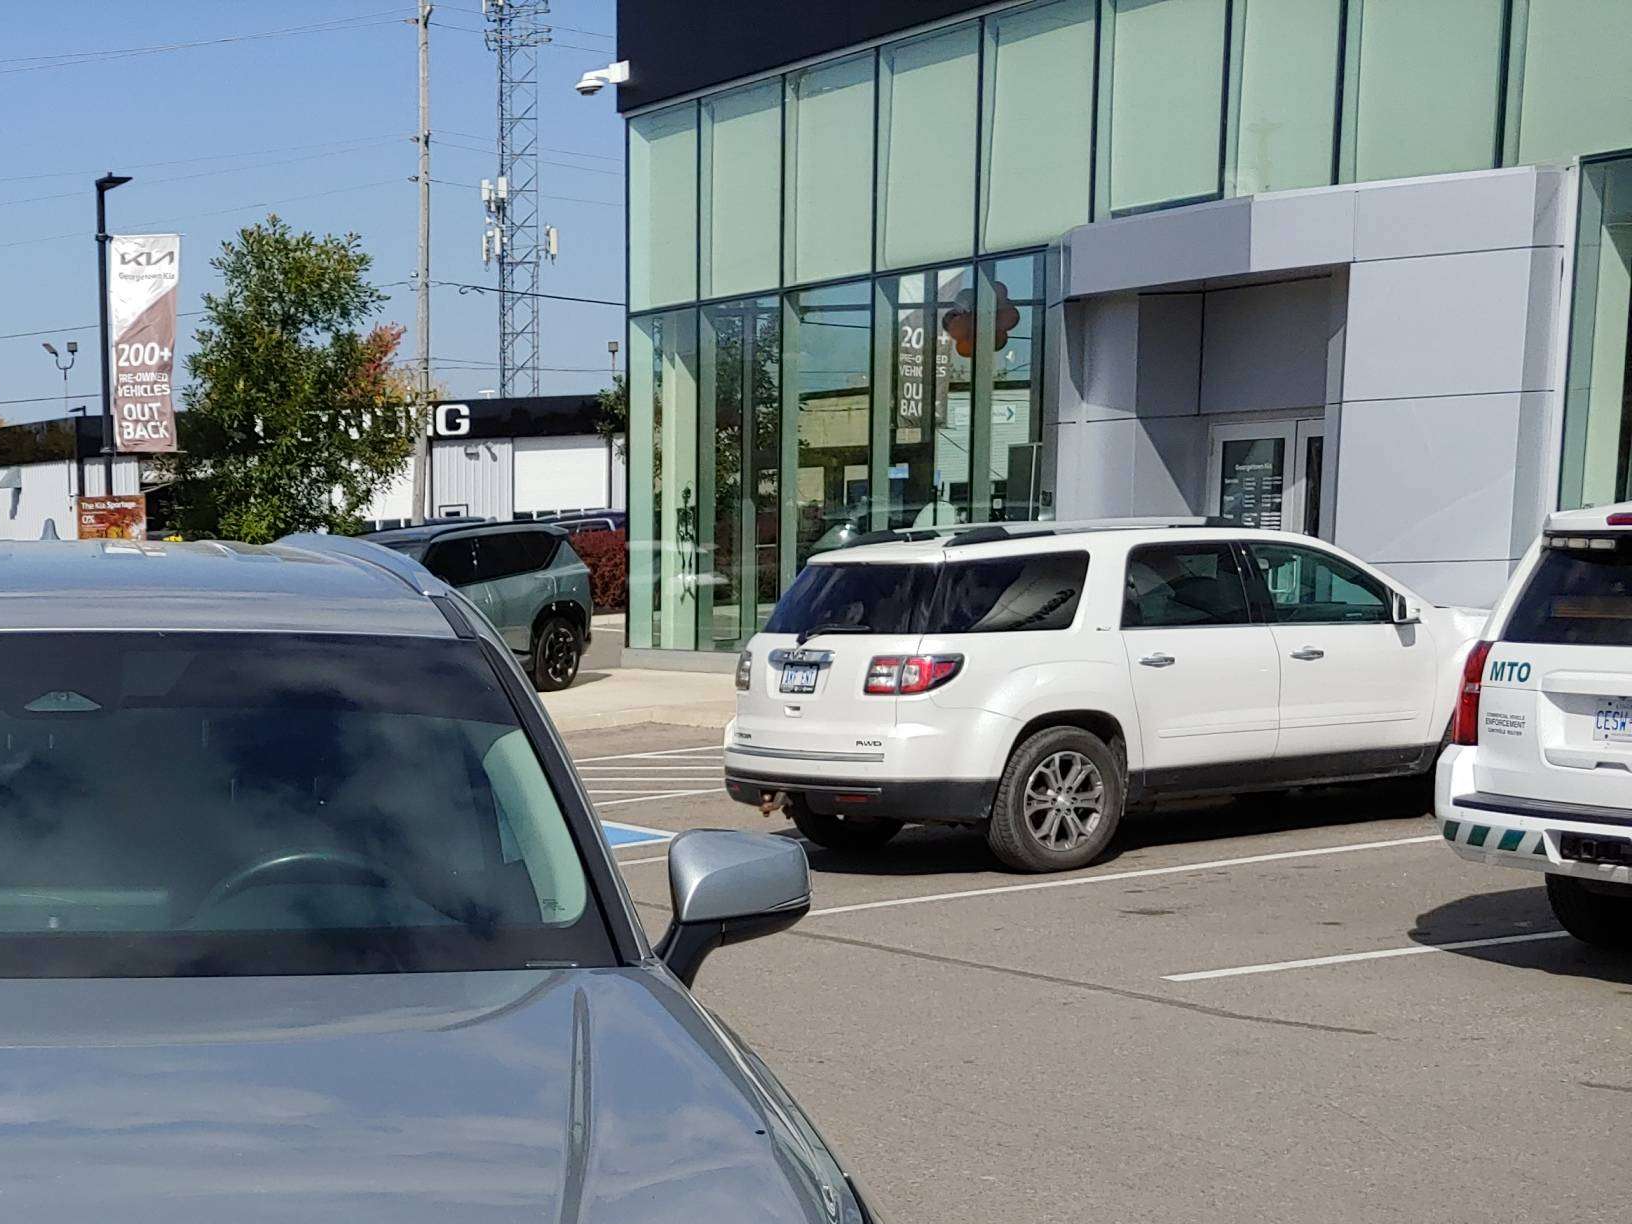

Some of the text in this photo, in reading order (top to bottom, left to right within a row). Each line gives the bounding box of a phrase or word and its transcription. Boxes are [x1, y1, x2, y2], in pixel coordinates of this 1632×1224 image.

[120, 251, 174, 266] KIA
[119, 272, 175, 282] Georgetown Kia
[900, 325, 949, 349] 20+
[117, 342, 172, 367] 200+
[900, 353, 948, 364] PRE-OED
[899, 364, 947, 378] VEHIES
[118, 384, 171, 397] VEHICLES
[903, 382, 923, 400] OU
[123, 402, 161, 421] OUT
[121, 421, 170, 439] BACK
[81, 501, 137, 512] The Kia Sportage
[1489, 661, 1531, 683] MTO
[1485, 717, 1526, 728] ENFORCEMENT
